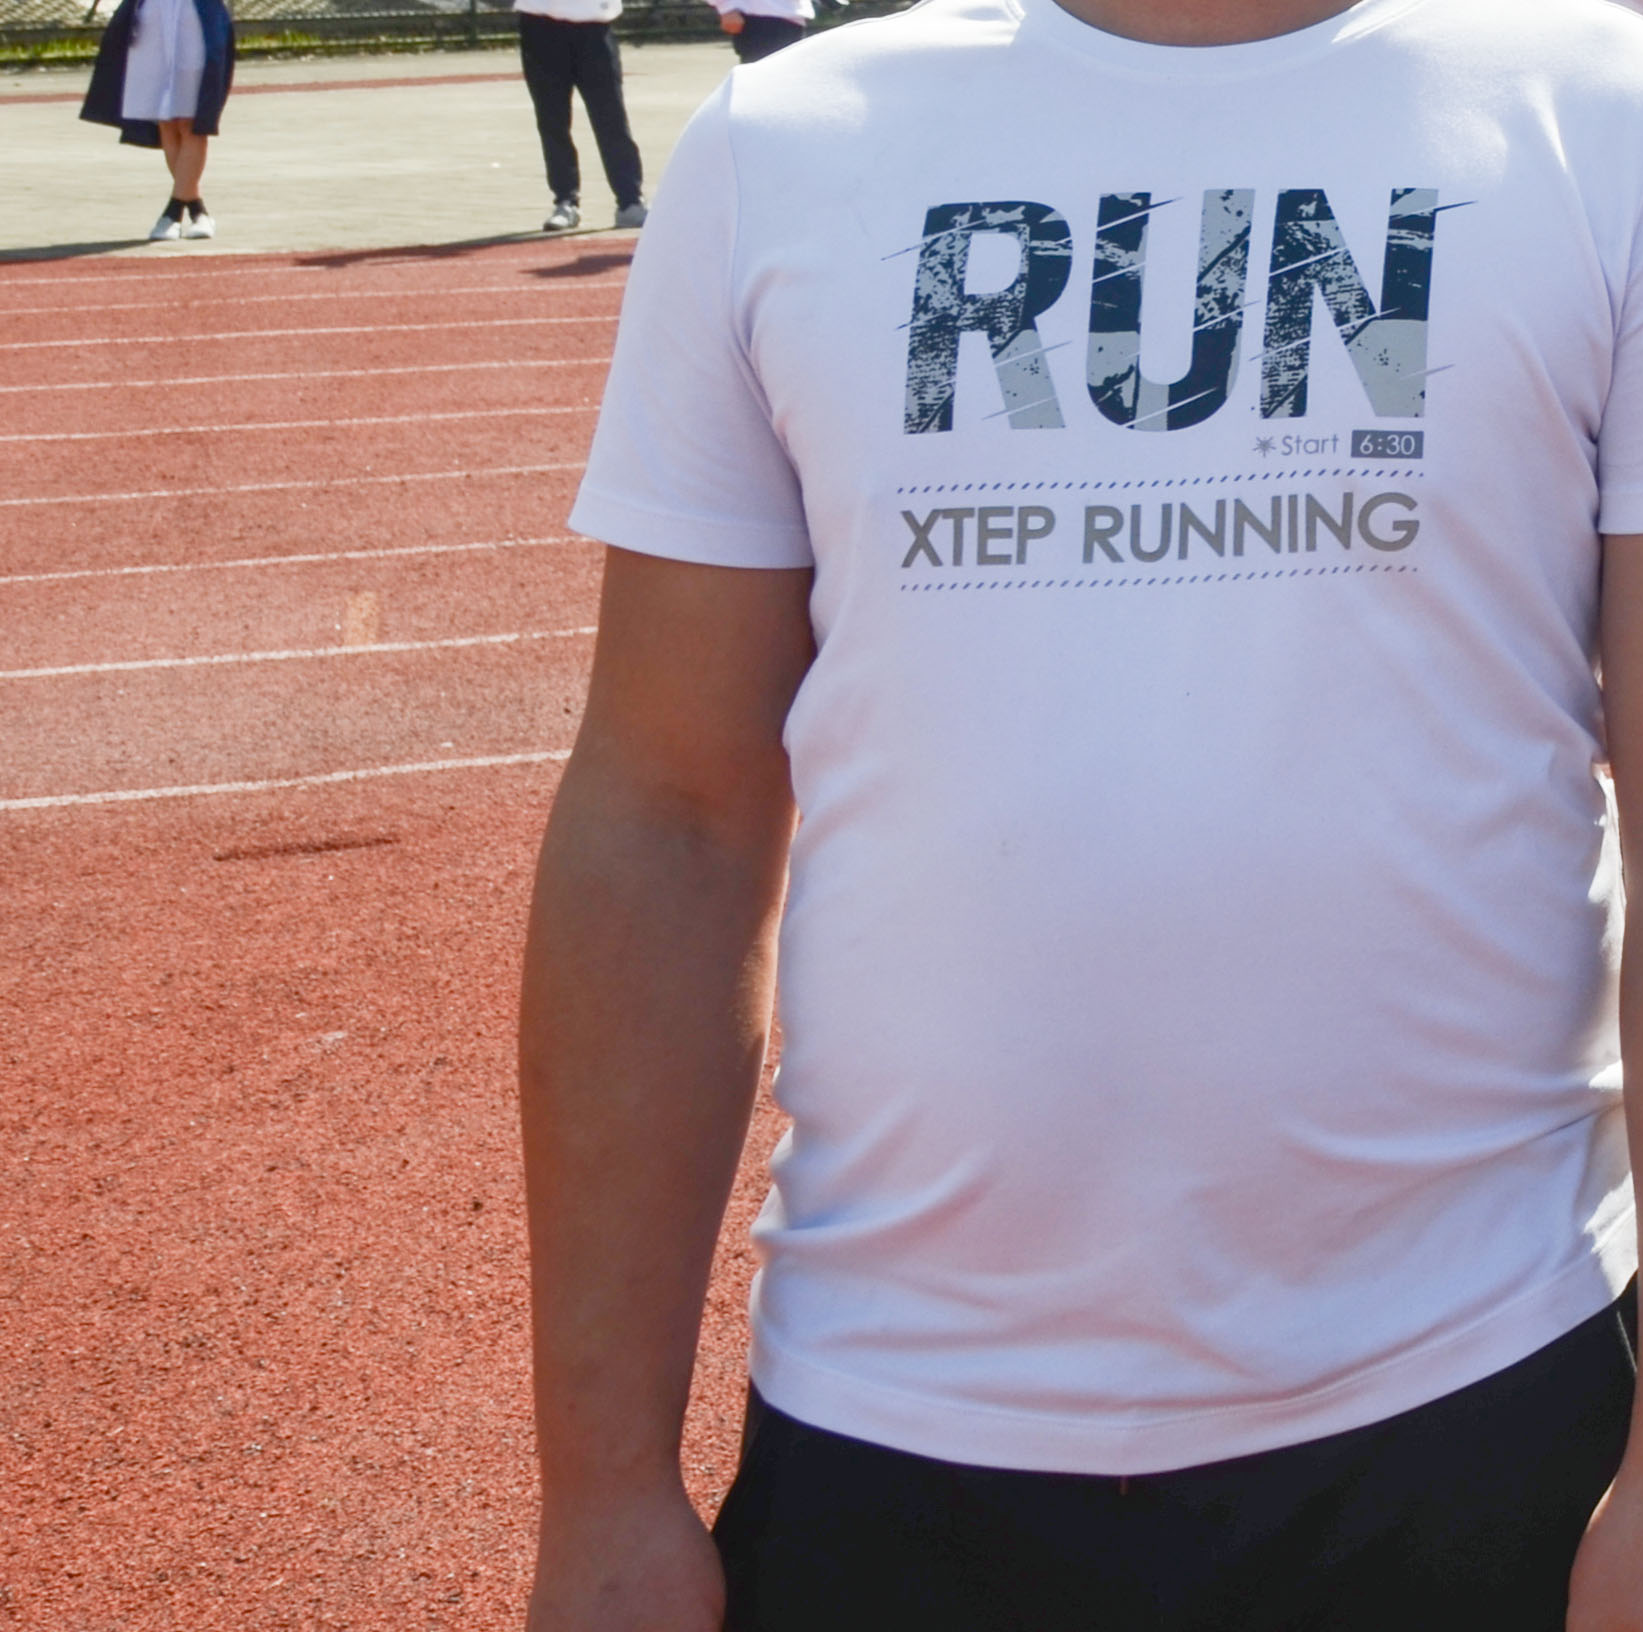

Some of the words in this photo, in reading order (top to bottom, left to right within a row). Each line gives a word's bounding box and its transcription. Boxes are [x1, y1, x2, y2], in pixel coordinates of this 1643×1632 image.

[902, 187, 1440, 435] RUN
[1280, 434, 1340, 456] Start
[1358, 433, 1417, 457] 6:30
[901, 505, 1056, 569] XTEP
[1082, 491, 1420, 565] RUNNING
